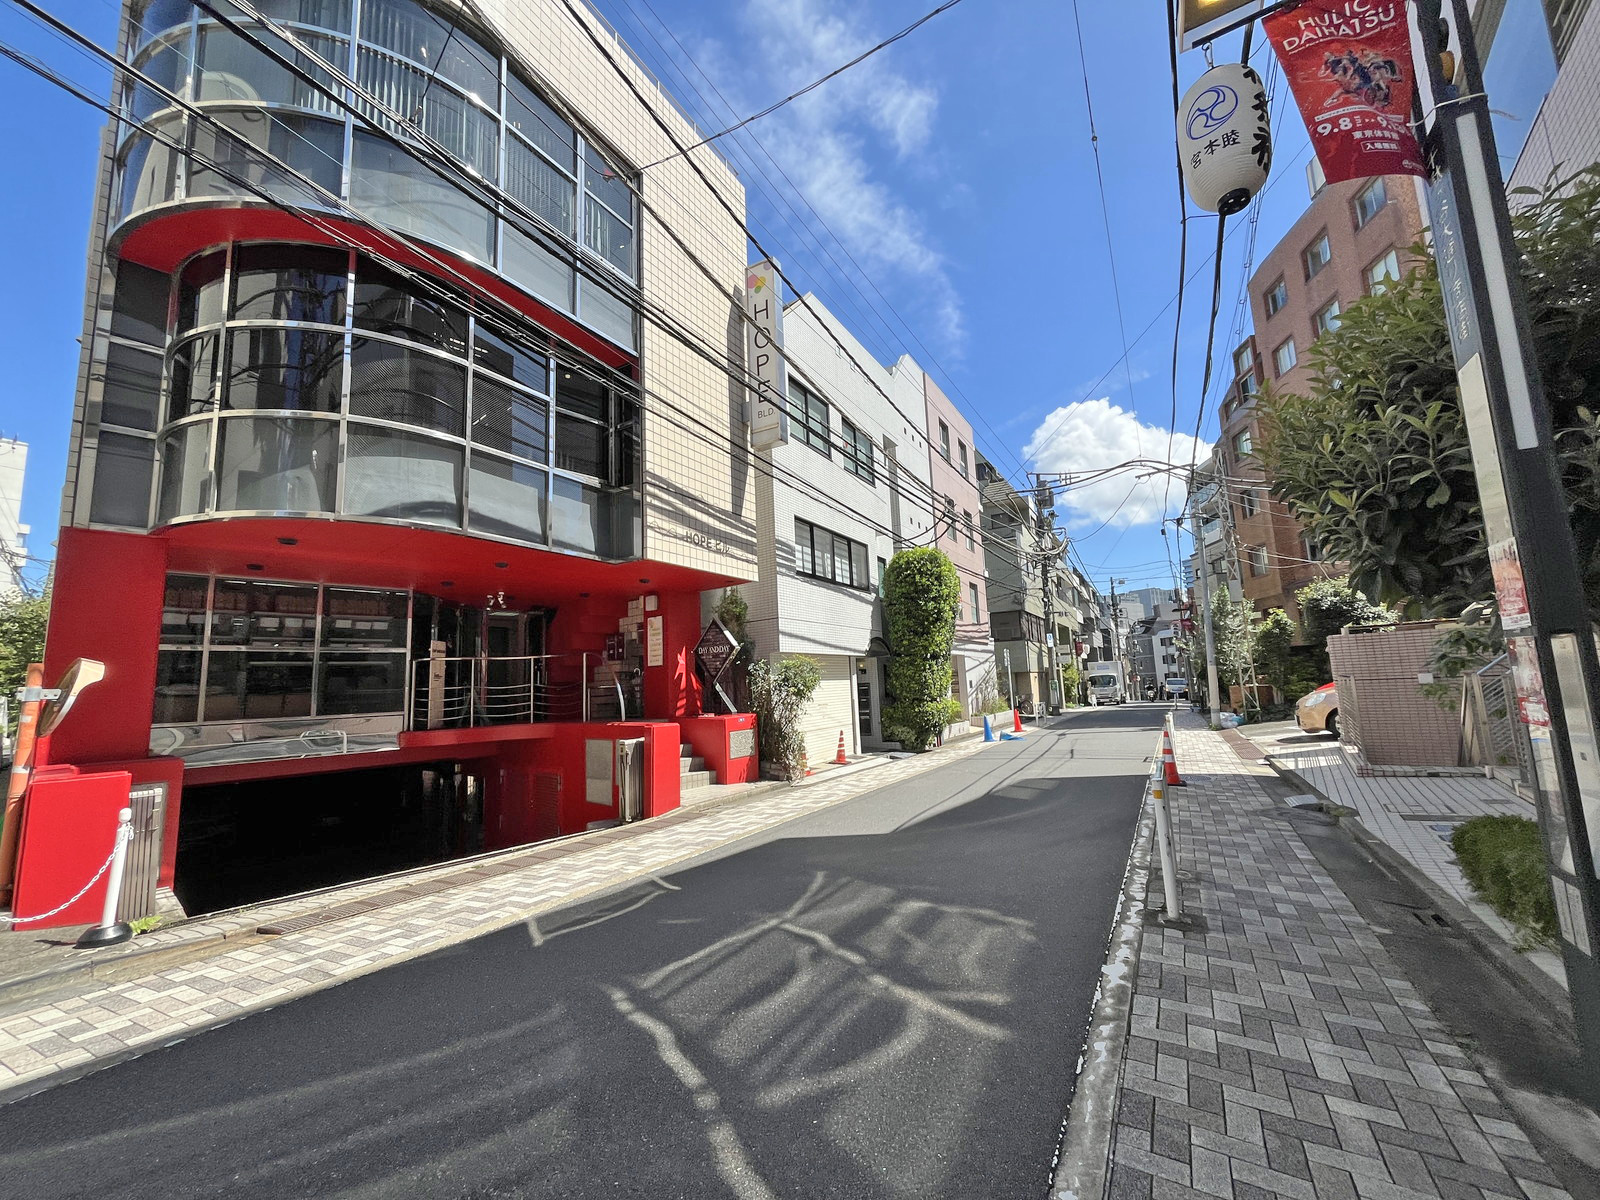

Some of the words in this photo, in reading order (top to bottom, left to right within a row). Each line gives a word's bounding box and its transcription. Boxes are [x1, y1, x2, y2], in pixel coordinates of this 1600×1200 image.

[1283, 3, 1396, 51] DAIHATSU
[1298, 0, 1370, 30] HULIC
[1317, 117, 1353, 136] 9.8
[1190, 129, 1241, 170] 宮本睦
[753, 298, 772, 404] HOPE
[684, 530, 713, 550] HOPE
[698, 647, 709, 655] DAY
